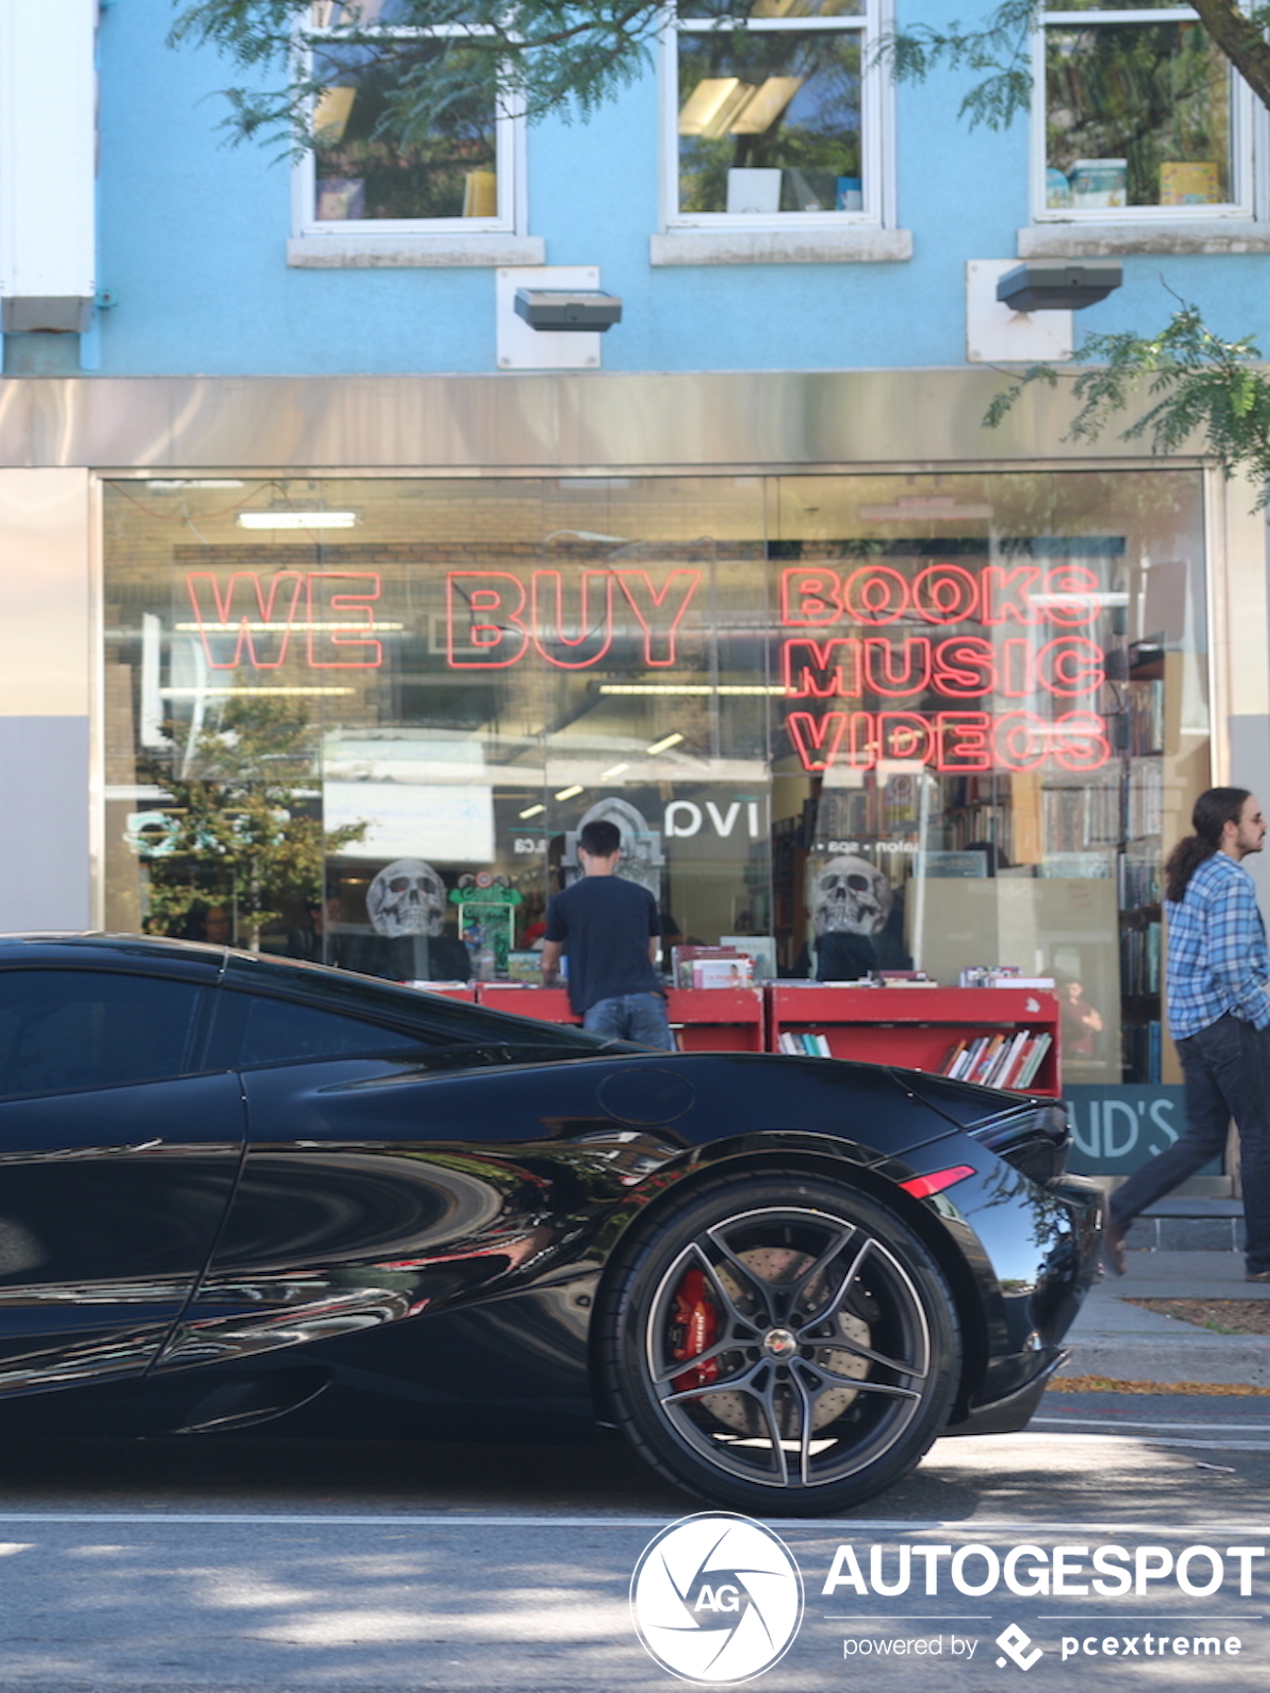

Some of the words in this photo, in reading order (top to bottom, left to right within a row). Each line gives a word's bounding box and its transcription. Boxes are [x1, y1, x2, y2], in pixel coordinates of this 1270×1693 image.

[185, 571, 383, 669] WE
[446, 568, 701, 669] BUY
[778, 563, 1102, 628] BOOKS
[781, 636, 1106, 699] MUSIC
[785, 710, 1112, 773] VIDEOS
